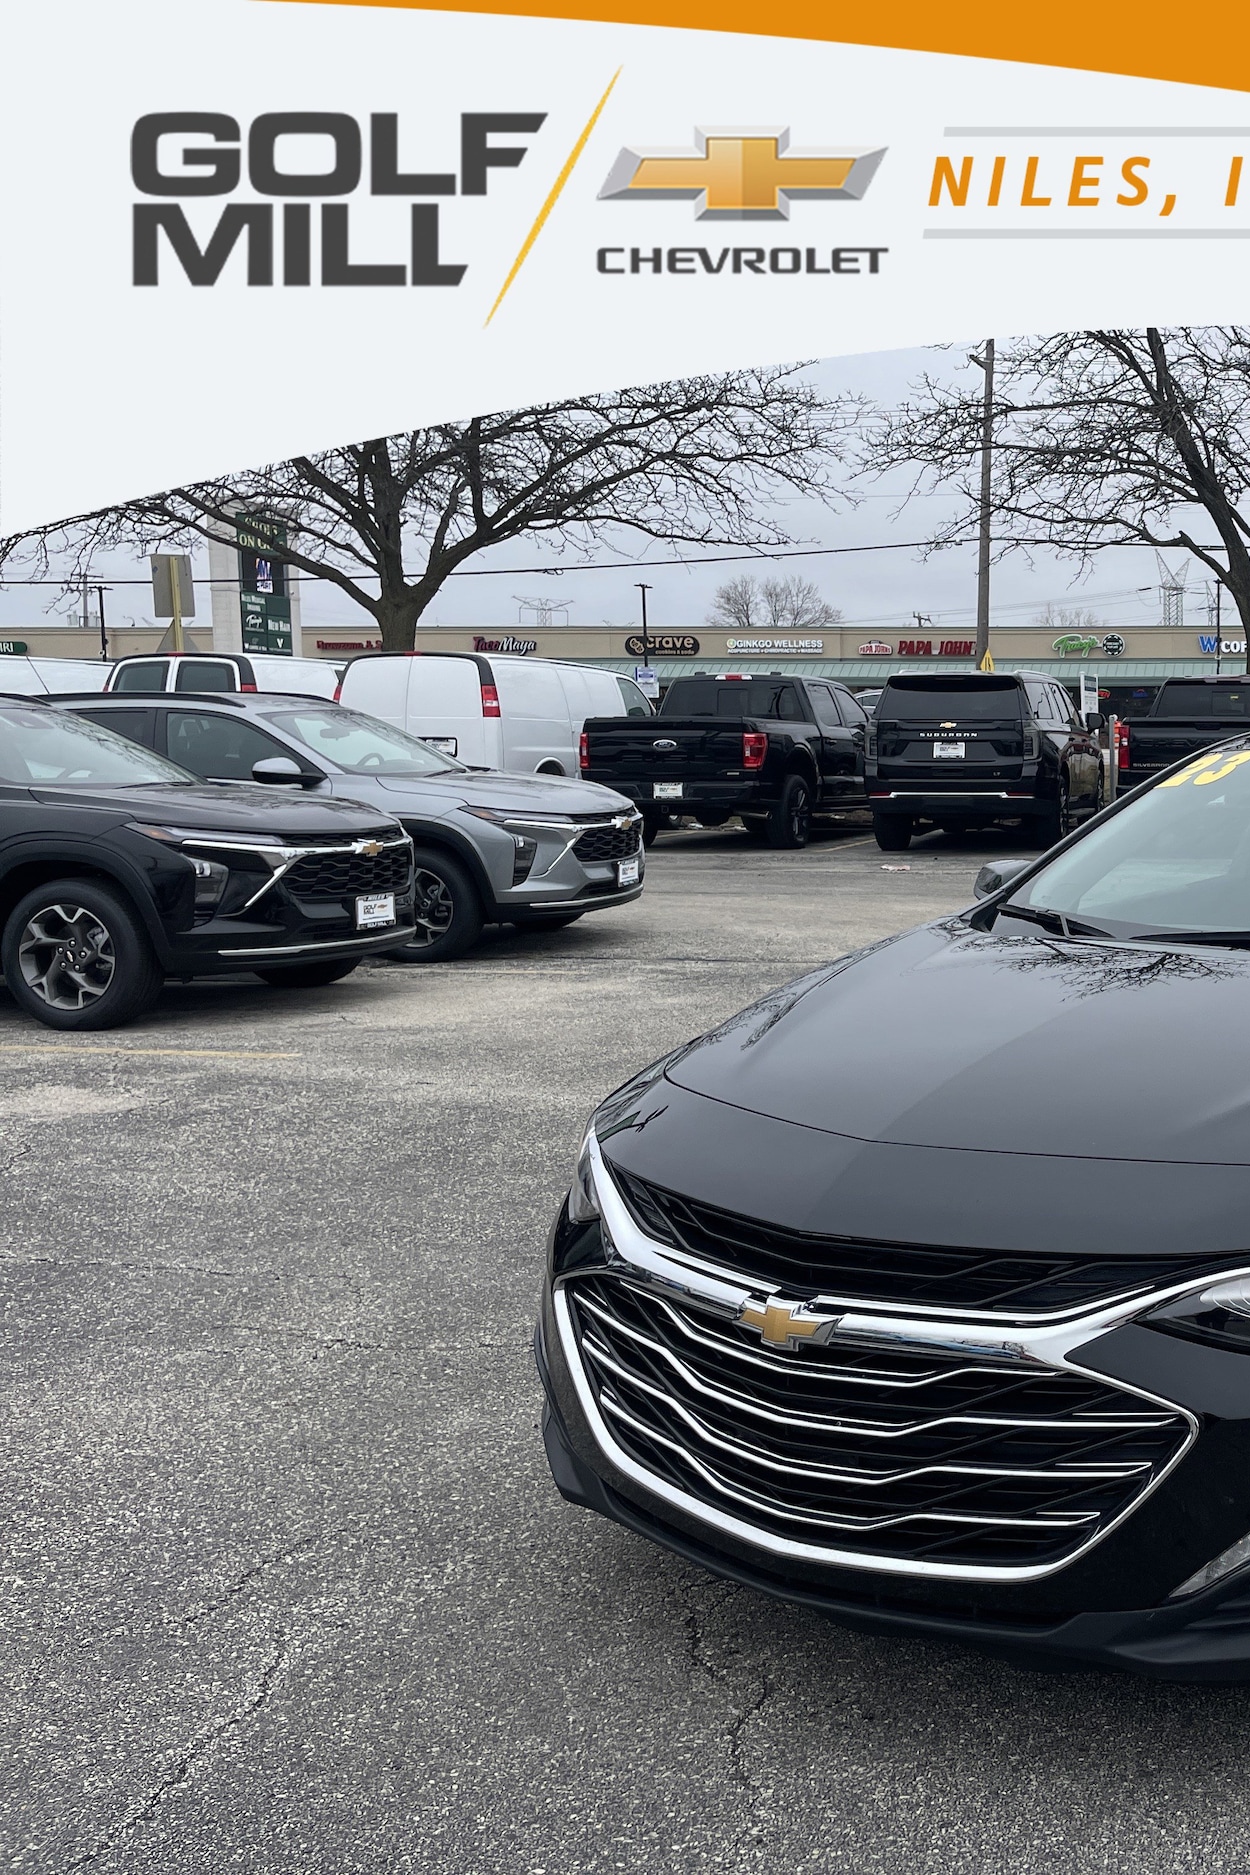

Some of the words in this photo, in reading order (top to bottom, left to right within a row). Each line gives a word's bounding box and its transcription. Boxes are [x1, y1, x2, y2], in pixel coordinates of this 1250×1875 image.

[646, 636, 694, 648] crave
[736, 640, 773, 648] GINKGO
[774, 640, 824, 648] WELLNESS
[898, 640, 932, 655] PAPA
